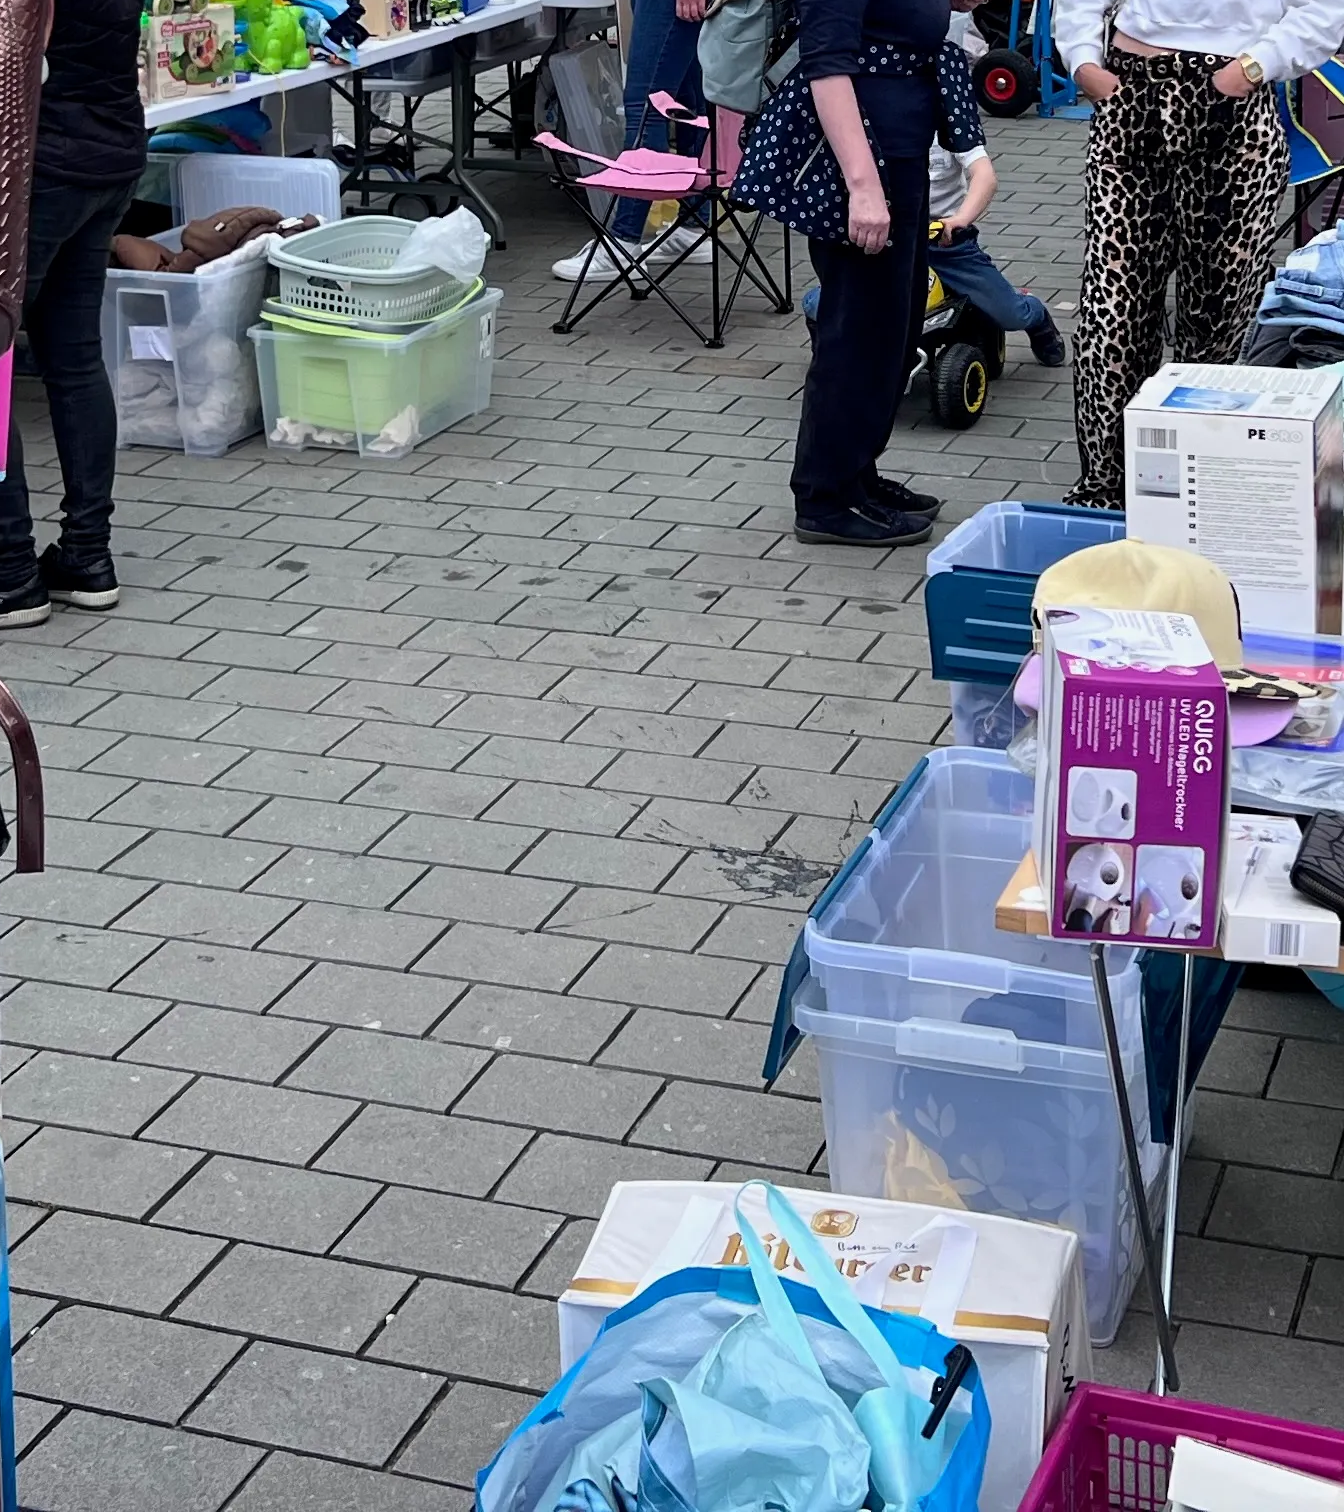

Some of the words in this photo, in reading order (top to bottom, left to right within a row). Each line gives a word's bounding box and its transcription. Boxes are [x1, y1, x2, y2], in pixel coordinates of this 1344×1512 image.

[1248, 428, 1304, 443] PEGRO
[1179, 698, 1191, 716] UV
[1178, 717, 1190, 742] LED
[1193, 699, 1215, 774] QUIGG
[1174, 744, 1189, 831] Nageltrockner
